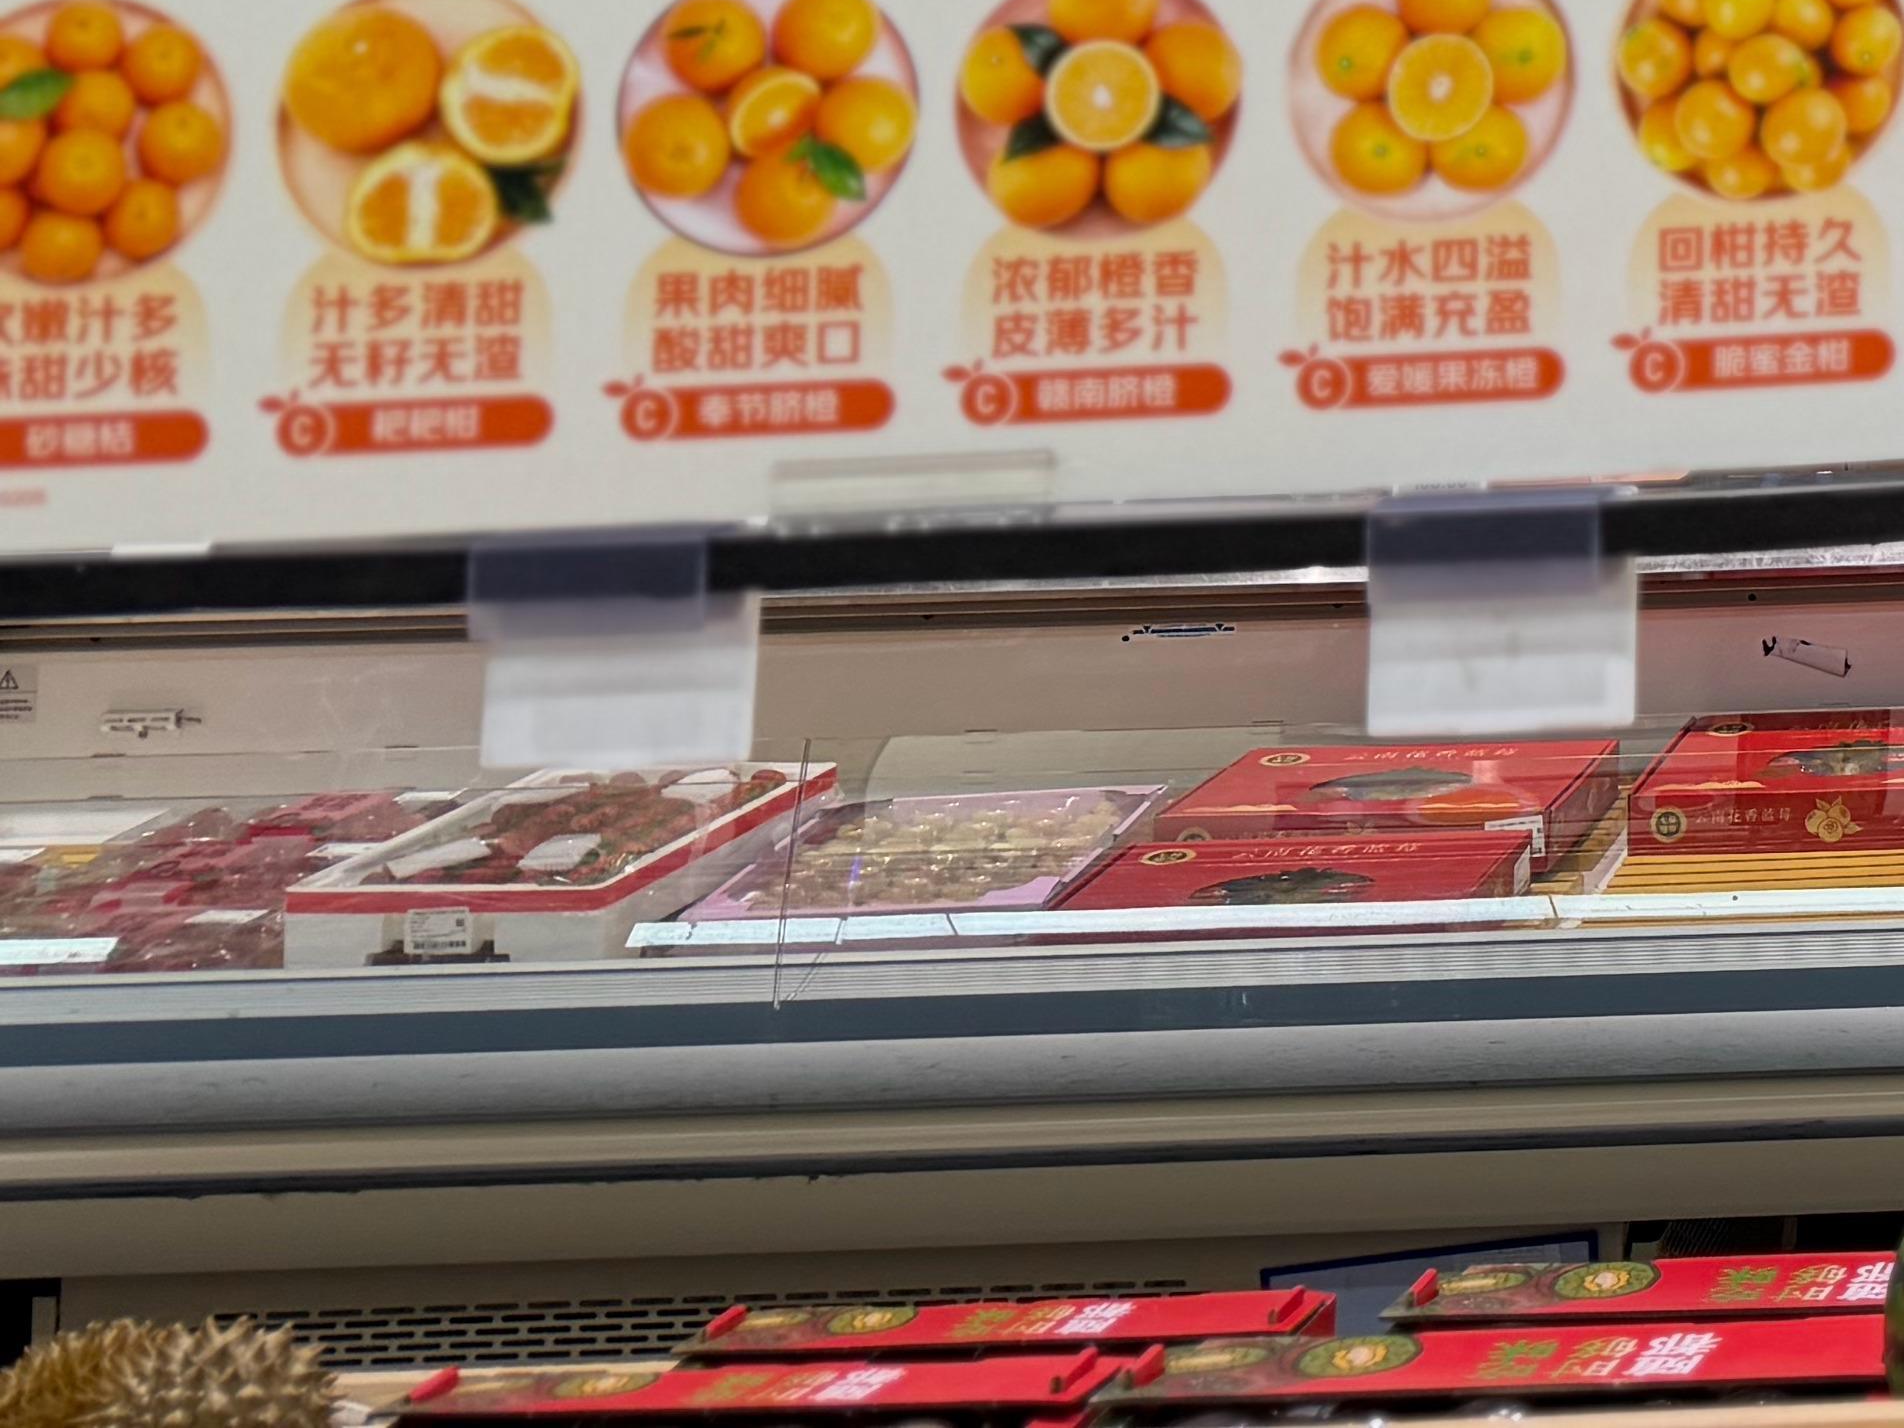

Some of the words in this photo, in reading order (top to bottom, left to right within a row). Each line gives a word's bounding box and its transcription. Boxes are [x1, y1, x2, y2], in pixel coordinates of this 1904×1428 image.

[1325, 234, 1533, 290] 汁水四溢
[1657, 217, 1863, 274] 回柑持久
[653, 264, 865, 319] 果肉细腻
[991, 249, 1198, 305] 浓郁橙香
[1657, 270, 1861, 327] 清甜无渣
[309, 278, 525, 335] 汁多清甜
[990, 303, 1198, 359] 皮薄多汁
[1325, 288, 1533, 343] 饱满充盈
[307, 334, 523, 390] 无籽无渣
[651, 319, 861, 374] 酸甜爽口
[1713, 338, 1854, 381] 脆蜜金柑
[1366, 356, 1539, 398] 爱媛果冻橙
